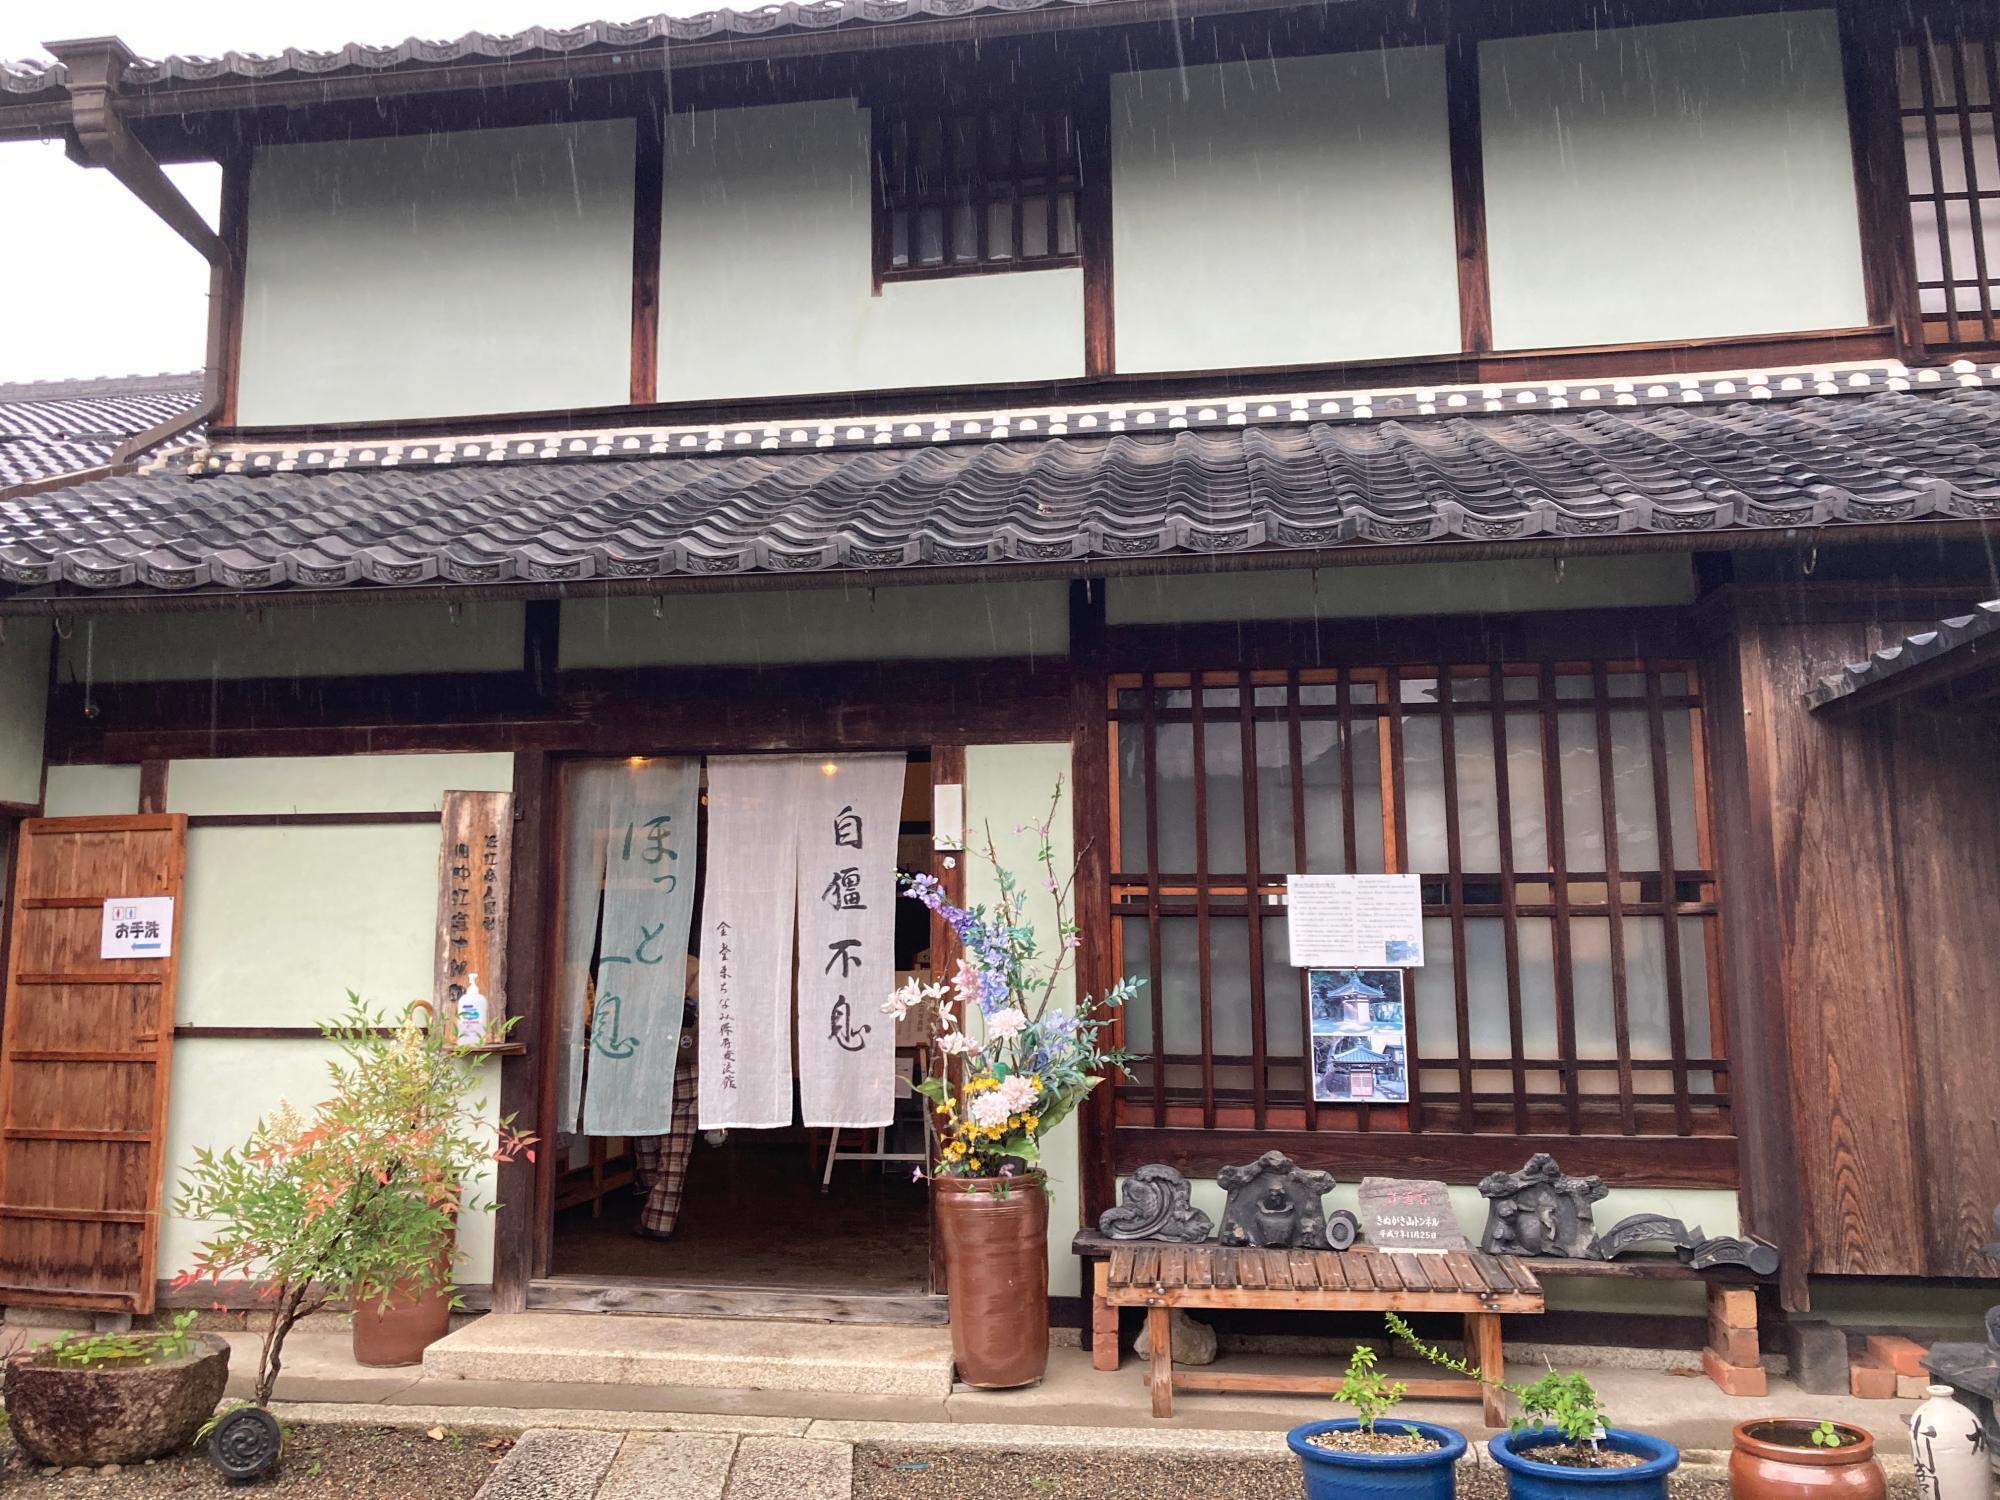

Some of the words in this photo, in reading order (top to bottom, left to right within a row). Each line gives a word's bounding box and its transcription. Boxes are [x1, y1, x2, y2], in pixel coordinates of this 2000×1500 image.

[115, 920, 160, 939] お手洗
[1375, 1215, 1440, 1228] きぬがさ山トンネル
